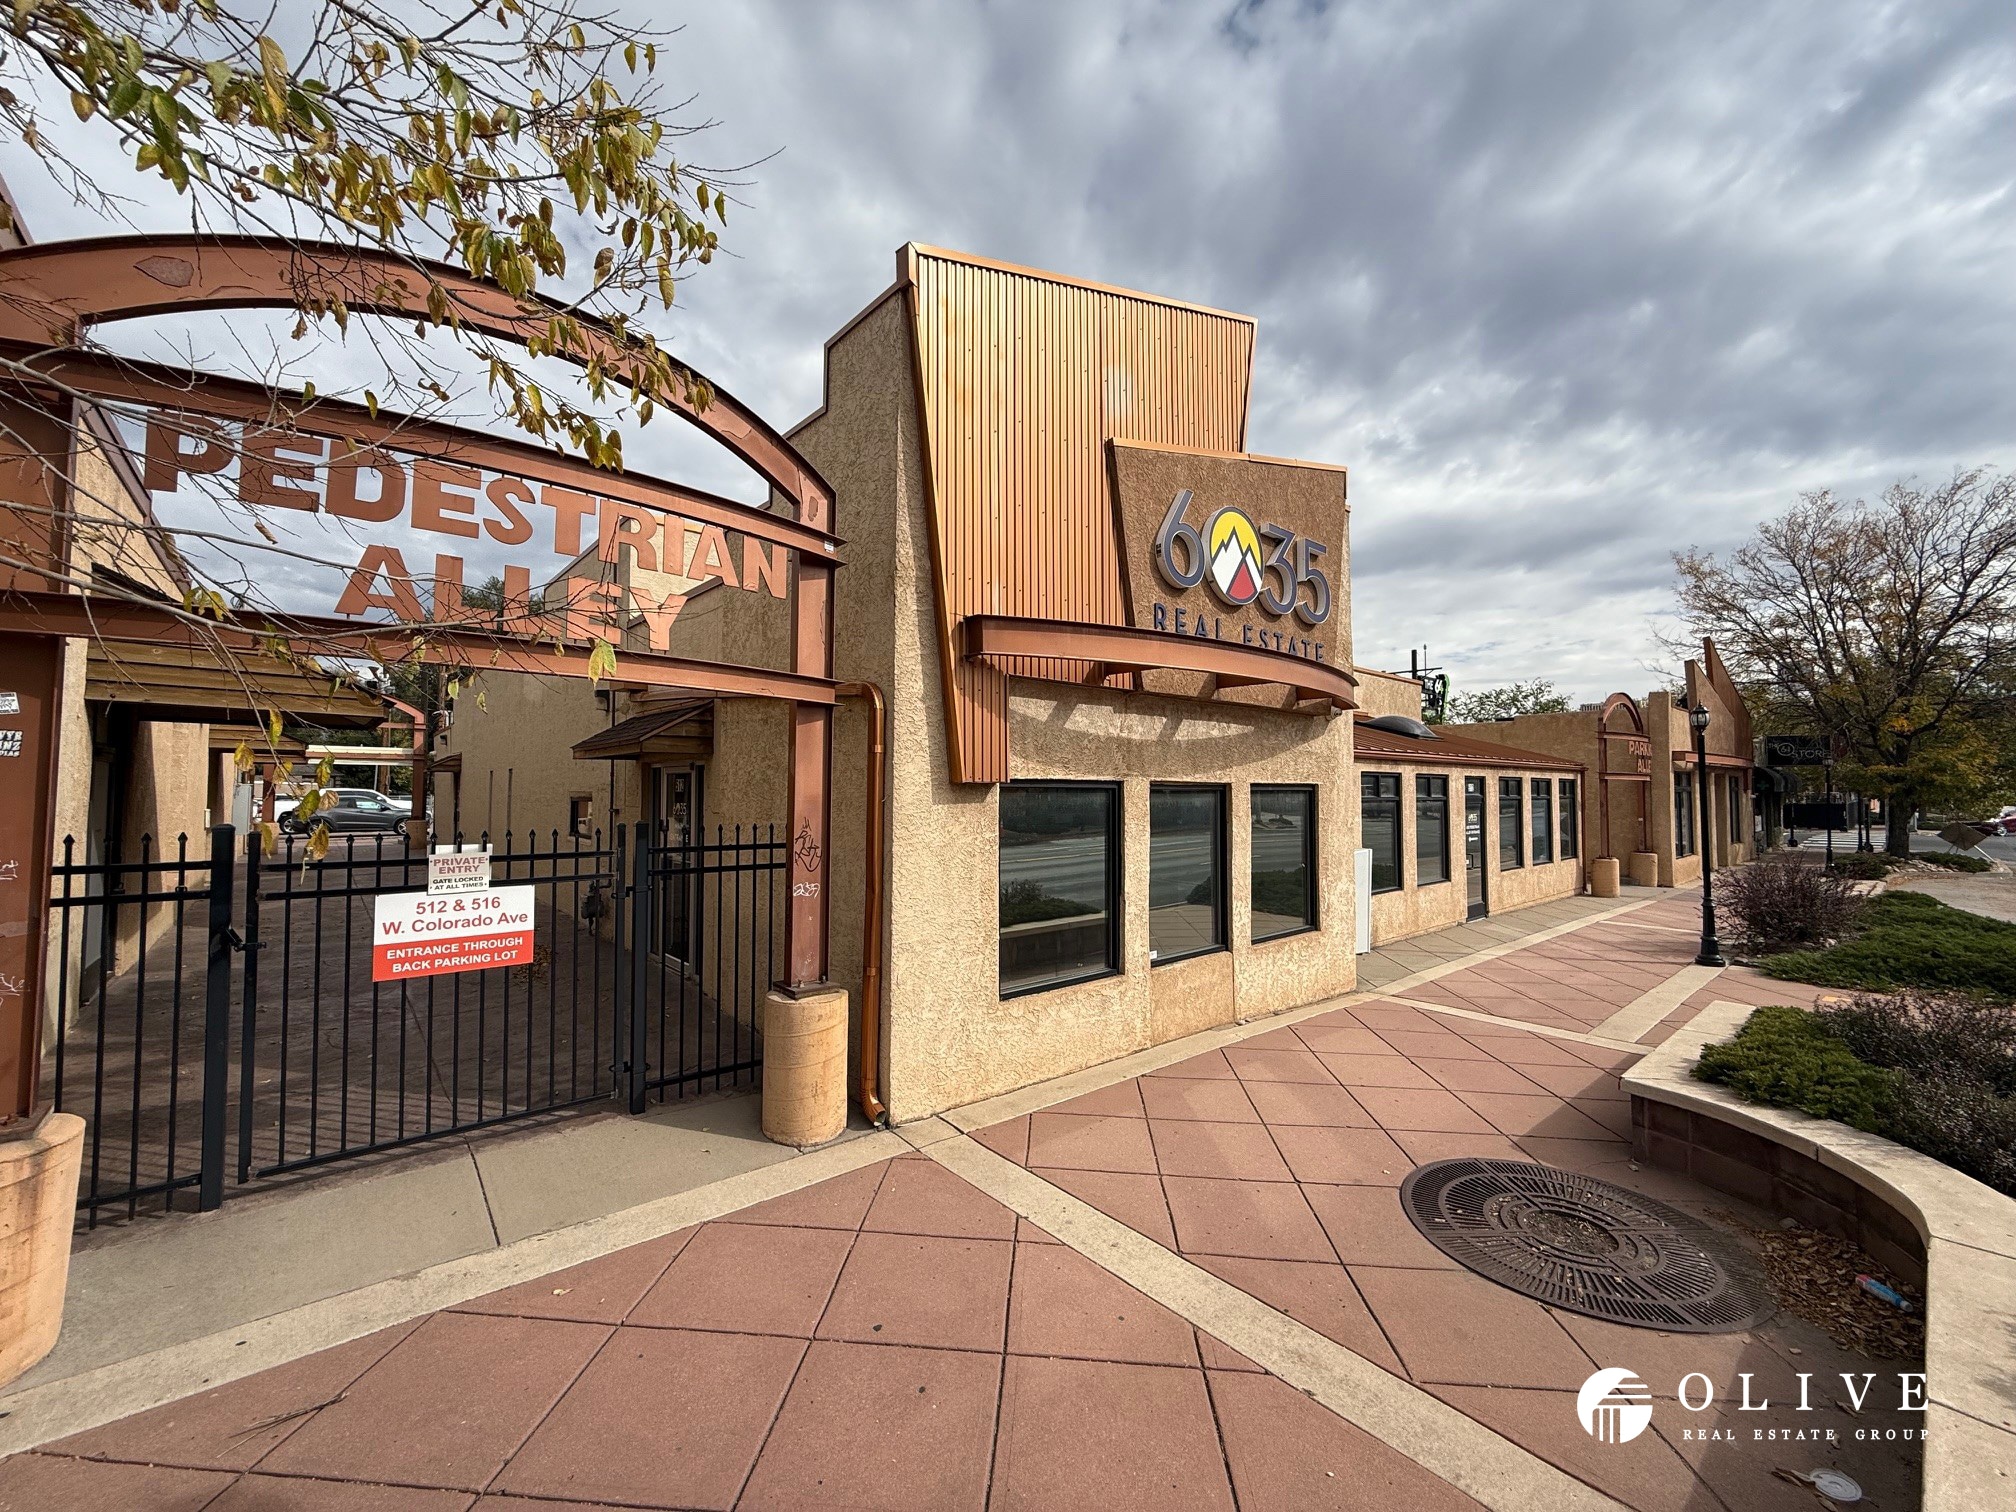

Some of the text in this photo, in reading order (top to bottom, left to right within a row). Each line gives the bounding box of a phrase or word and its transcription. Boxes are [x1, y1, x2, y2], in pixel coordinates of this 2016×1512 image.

[145, 409, 789, 600] PEDESTRIAN
[1155, 489, 1332, 625] 6035
[333, 544, 689, 651] ALLEY
[1153, 602, 1325, 663] REAL ESTATE
[433, 856, 486, 867] PRIVATE
[438, 864, 481, 875] ENTRY
[416, 896, 501, 915] 512 & 516
[382, 912, 529, 936] W. Colorado Ave
[386, 936, 524, 961] ENTRANCE THROUGH
[391, 949, 519, 974] BACK PARKING LOT
